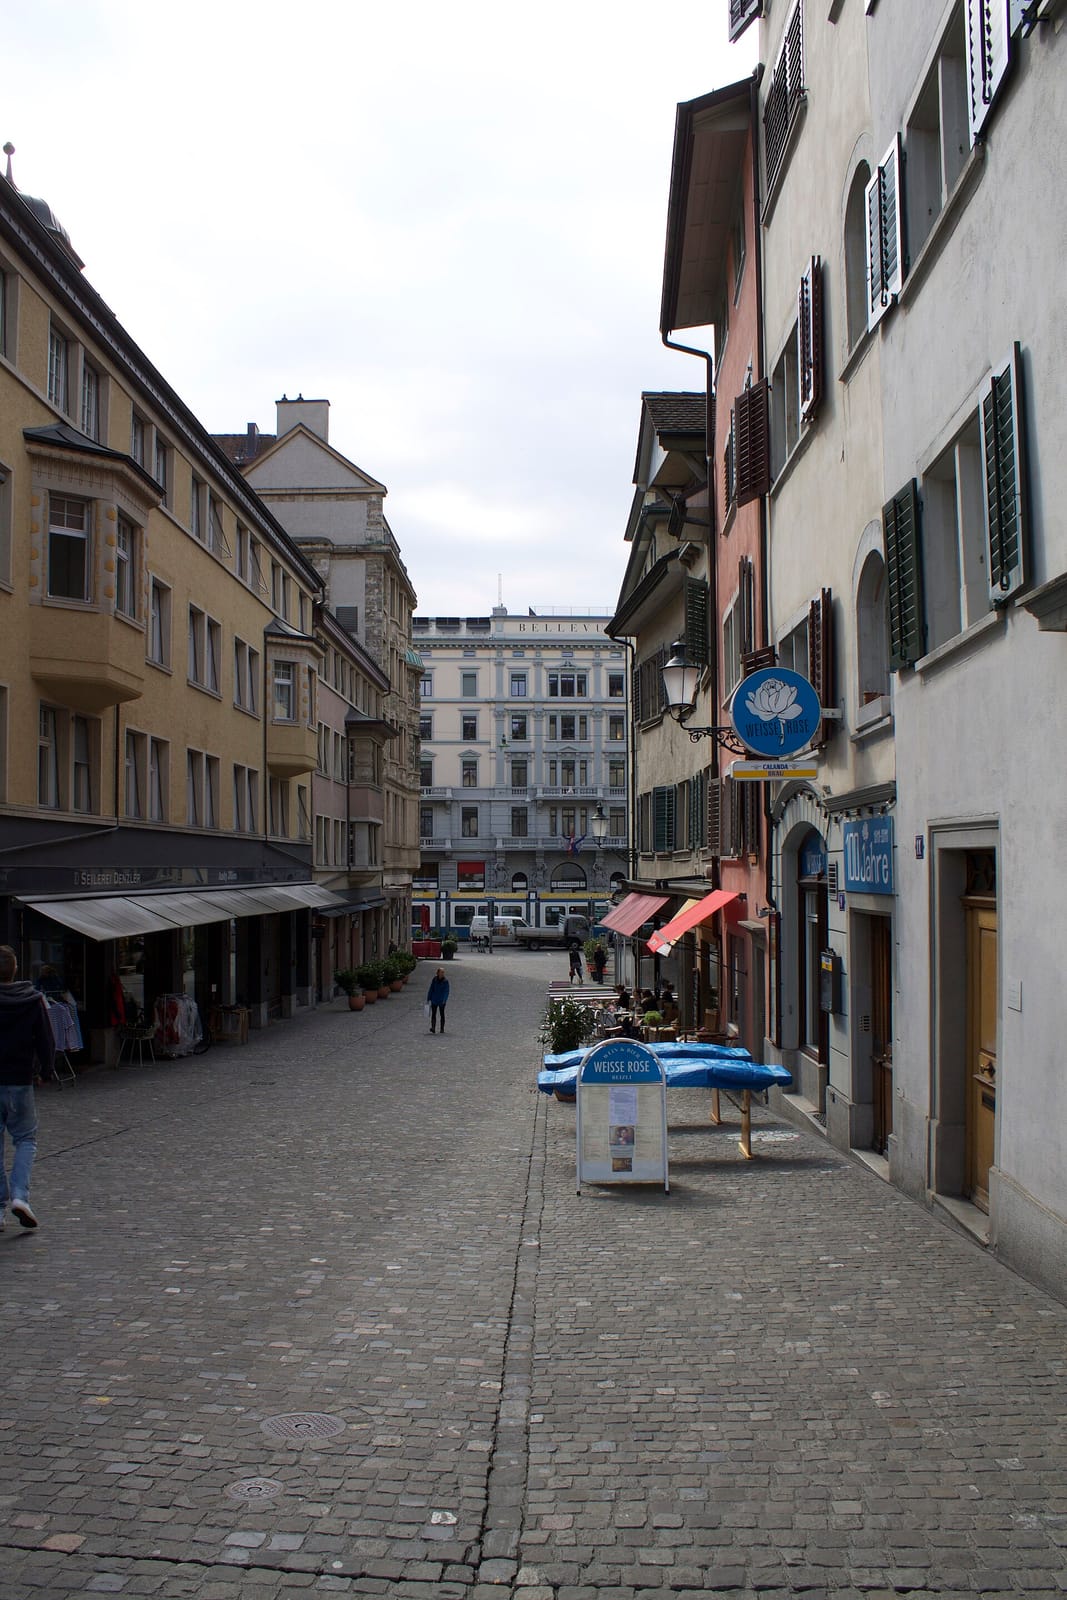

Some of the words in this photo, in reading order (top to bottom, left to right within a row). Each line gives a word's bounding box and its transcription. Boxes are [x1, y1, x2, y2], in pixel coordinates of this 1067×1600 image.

[746, 722, 778, 738] WEISSE
[786, 719, 809, 735] ROSE
[845, 832, 860, 881] 100
[860, 841, 889, 885] Jahre
[113, 872, 142, 884] DENZLER
[593, 1061, 625, 1073] WEISSE
[627, 1060, 650, 1072] ROSE
